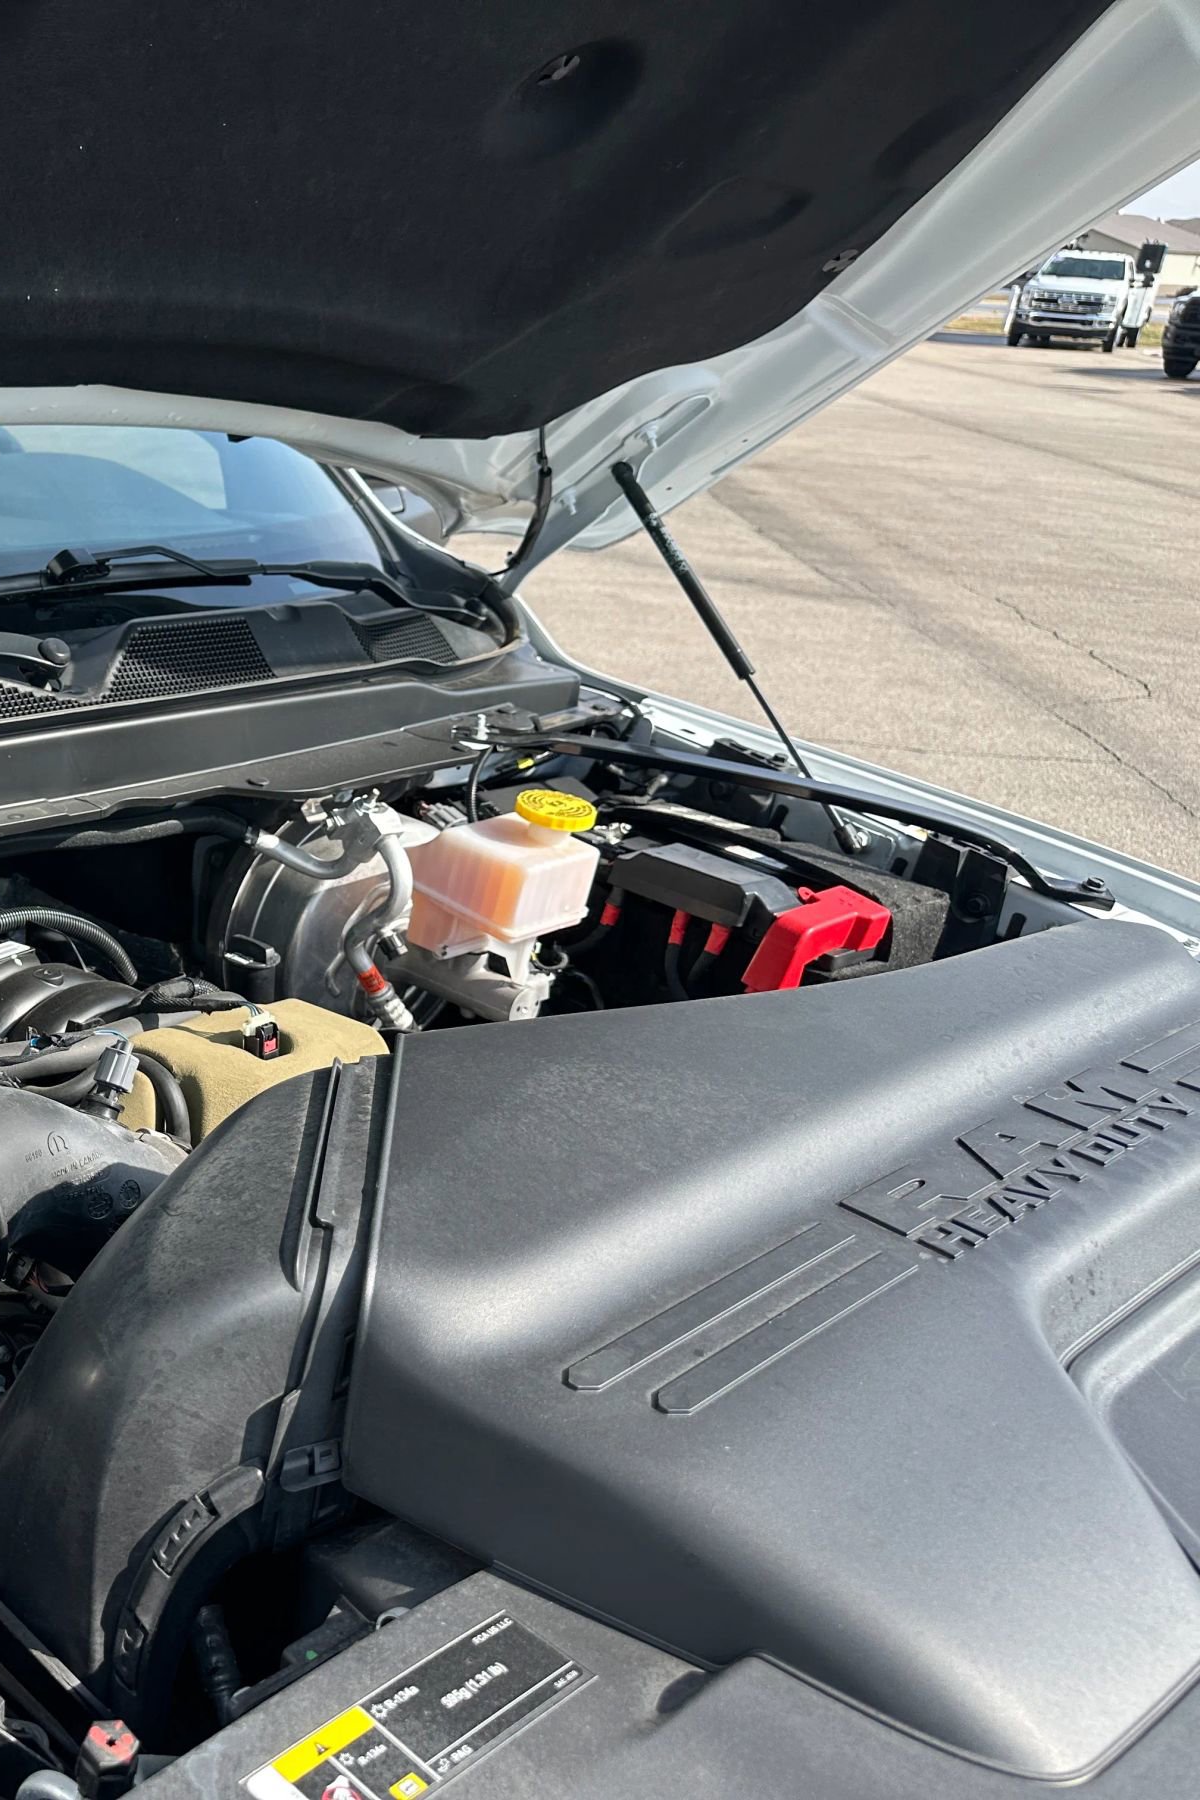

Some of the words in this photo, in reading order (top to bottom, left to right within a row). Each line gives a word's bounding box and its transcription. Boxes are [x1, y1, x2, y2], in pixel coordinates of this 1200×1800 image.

[837, 1067, 1159, 1237] RAM
[916, 1153, 1088, 1260] HEAVY
[1069, 1092, 1195, 1166] DUTY
[383, 1685, 420, 1711] R-134a
[450, 1744, 474, 1763] PAG
